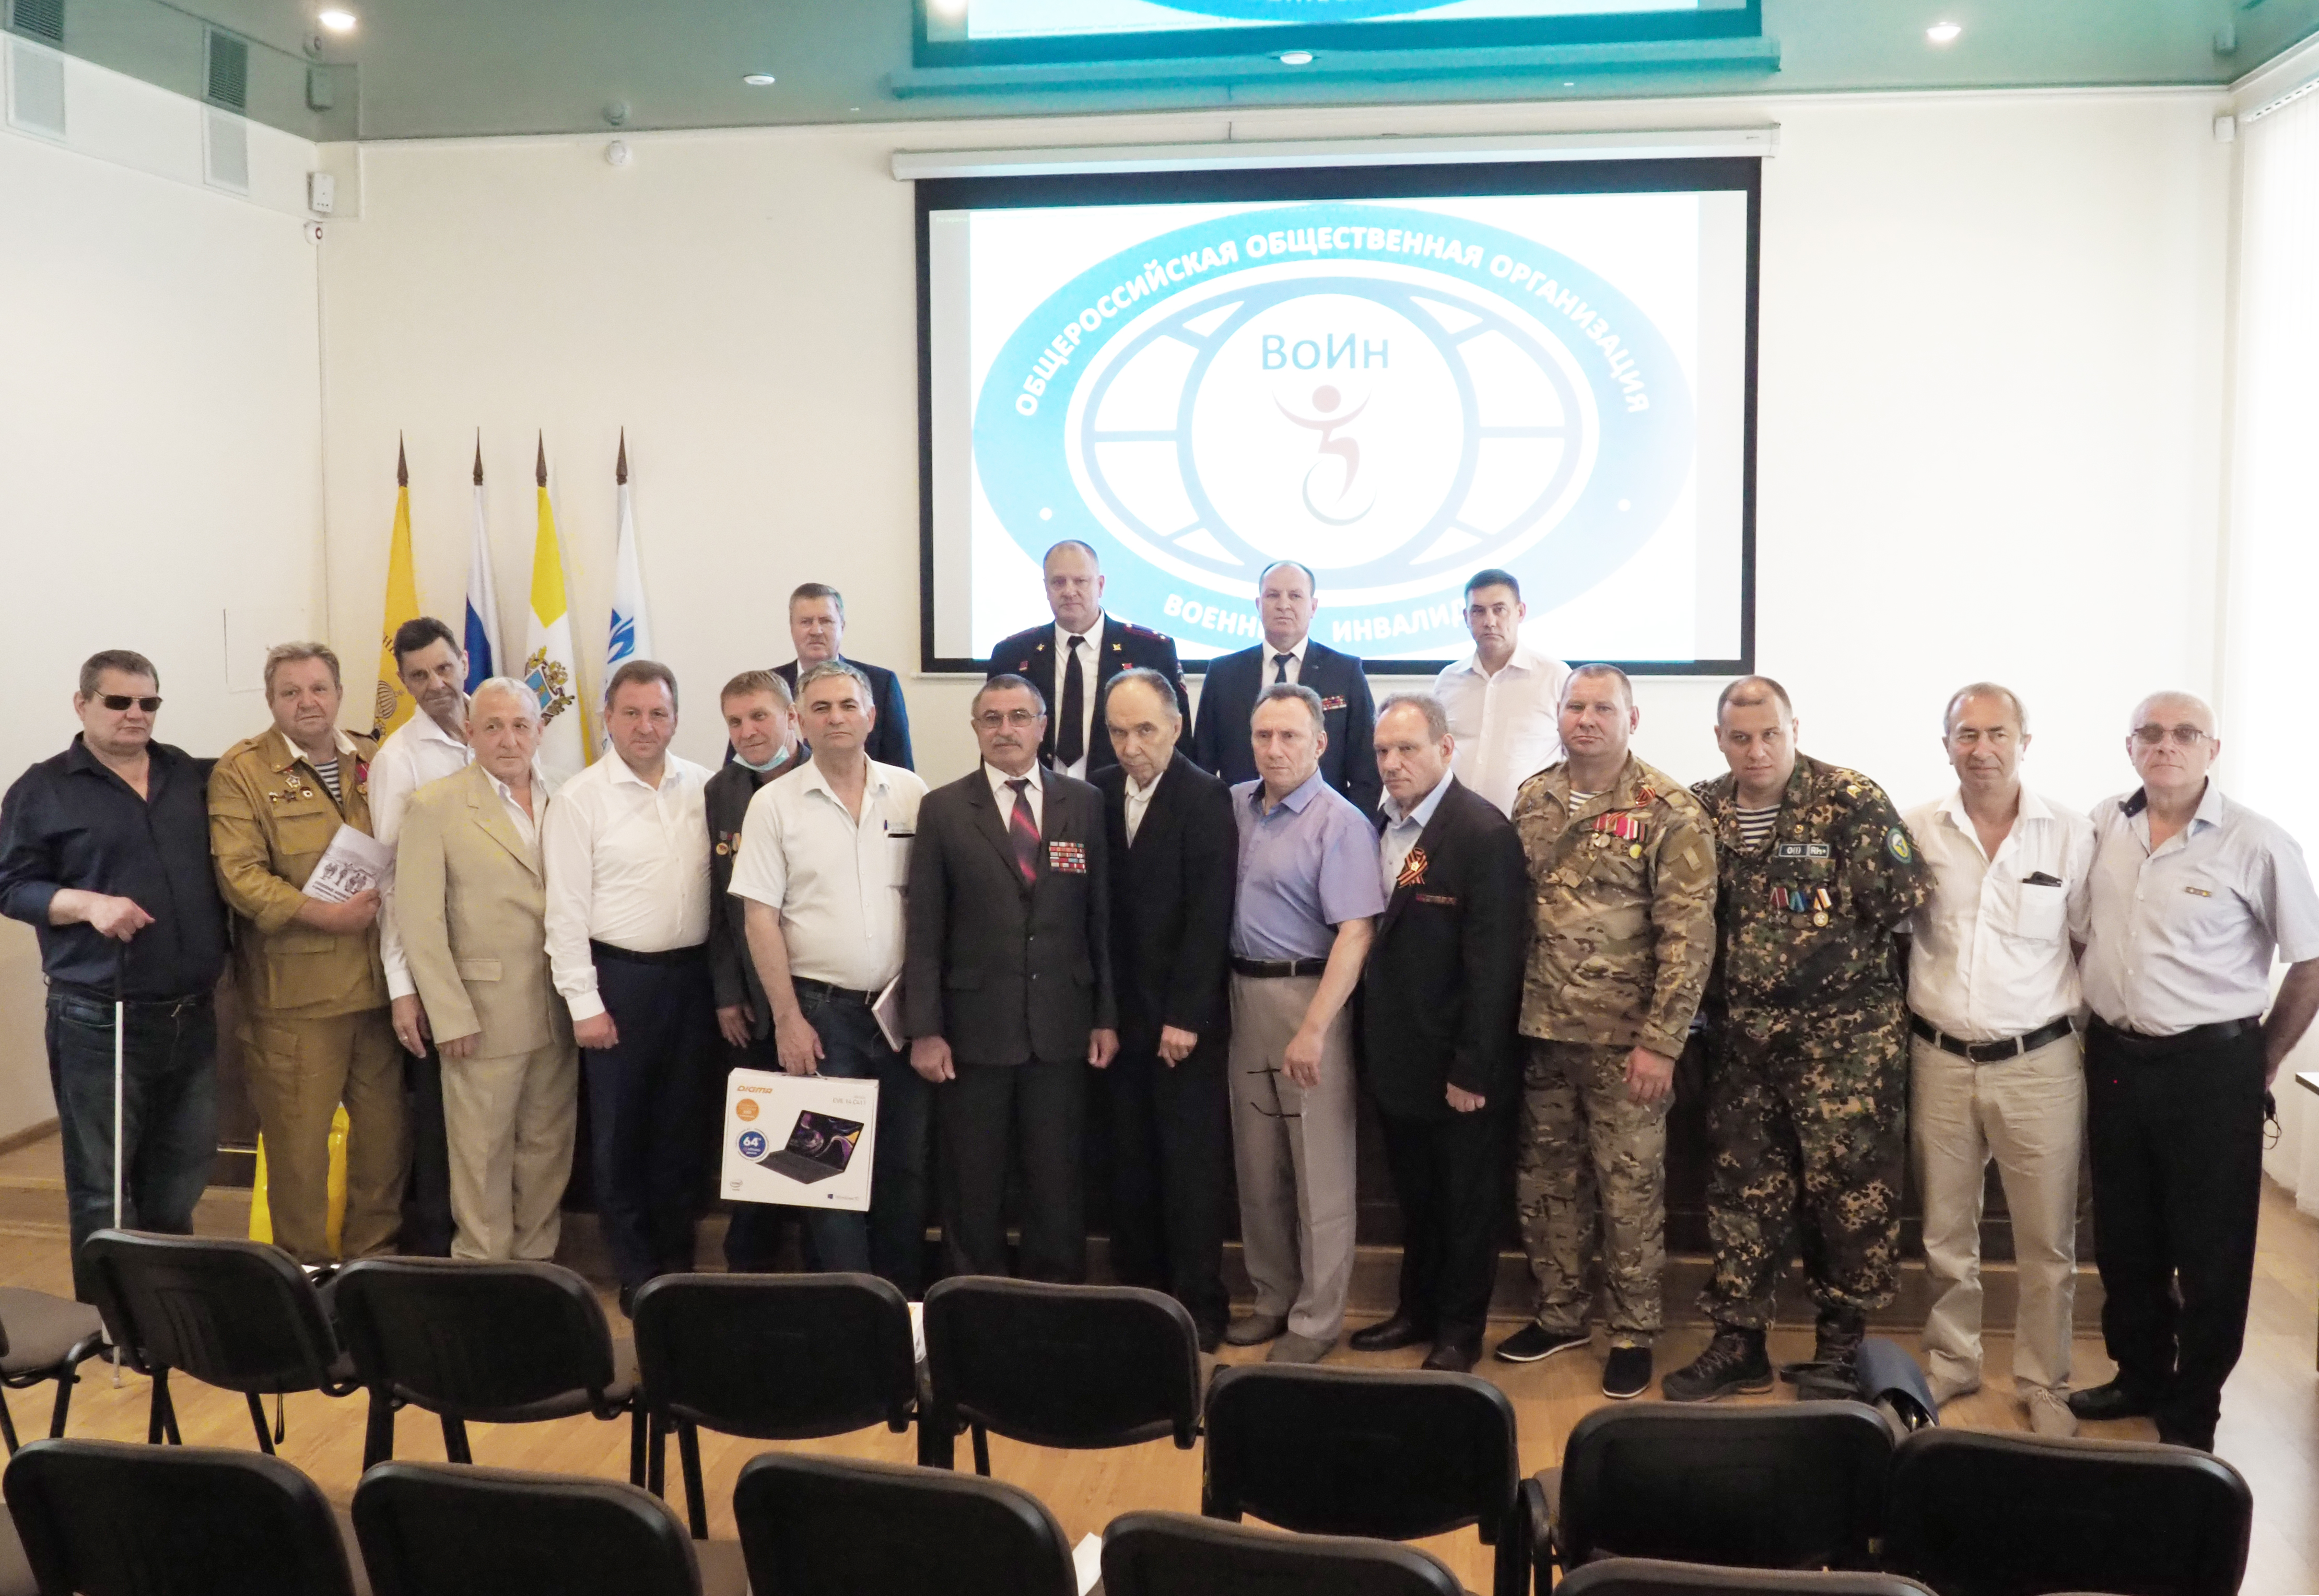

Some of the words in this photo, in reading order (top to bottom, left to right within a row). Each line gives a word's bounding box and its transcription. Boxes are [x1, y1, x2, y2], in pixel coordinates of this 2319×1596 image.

[1015, 240, 1239, 416] ОБЩЕРОССИЙСКАЯ
[1246, 227, 1484, 268] ОБЩЕСТВЕННАЯ
[1490, 254, 1649, 413] ОРГАНИЗАЦИЯ
[1262, 333, 1388, 370] ВоИн
[743, 1136, 758, 1147] 64
